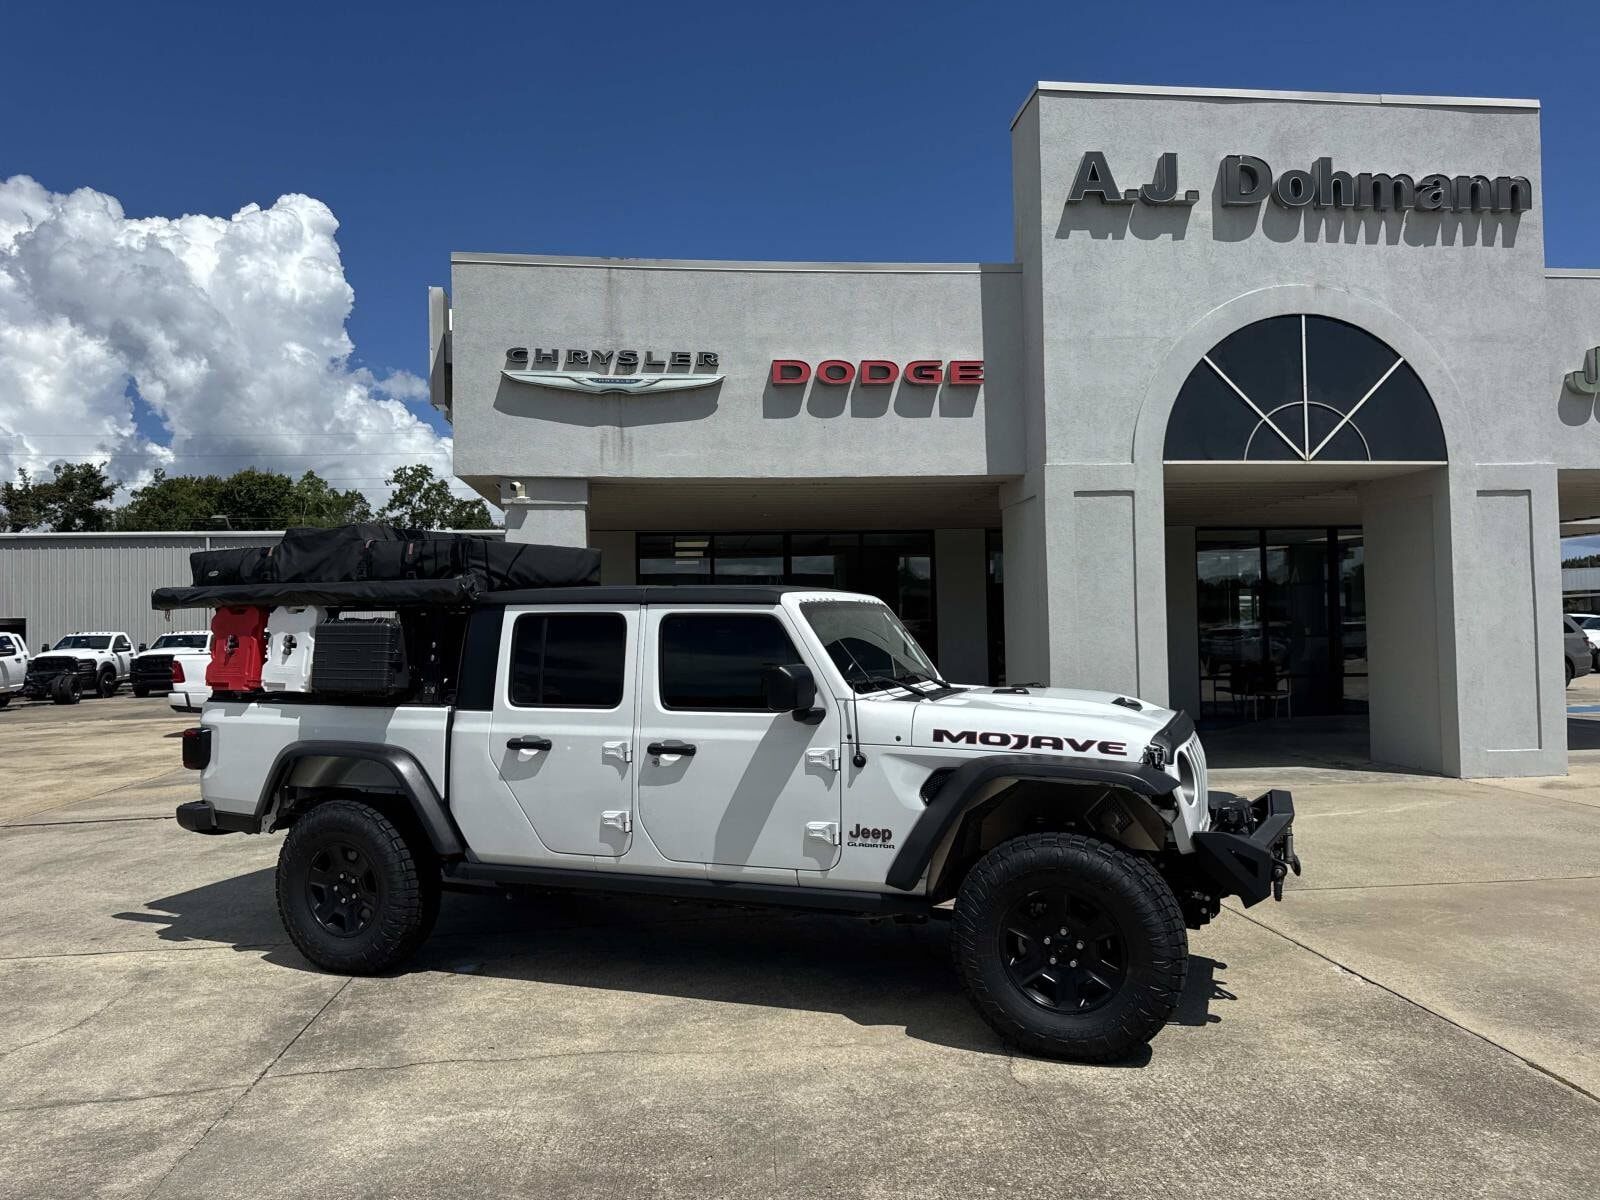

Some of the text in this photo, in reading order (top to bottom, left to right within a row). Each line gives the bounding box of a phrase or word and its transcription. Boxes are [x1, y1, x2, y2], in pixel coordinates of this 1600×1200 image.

[1067, 151, 1533, 213] A.J. Dohmann
[506, 347, 720, 366] CHRYSLER
[771, 360, 985, 385] DODGE
[933, 729, 1127, 756] MOJAVE
[849, 823, 893, 843] Jeep
[847, 841, 896, 850] GLADIATOR
